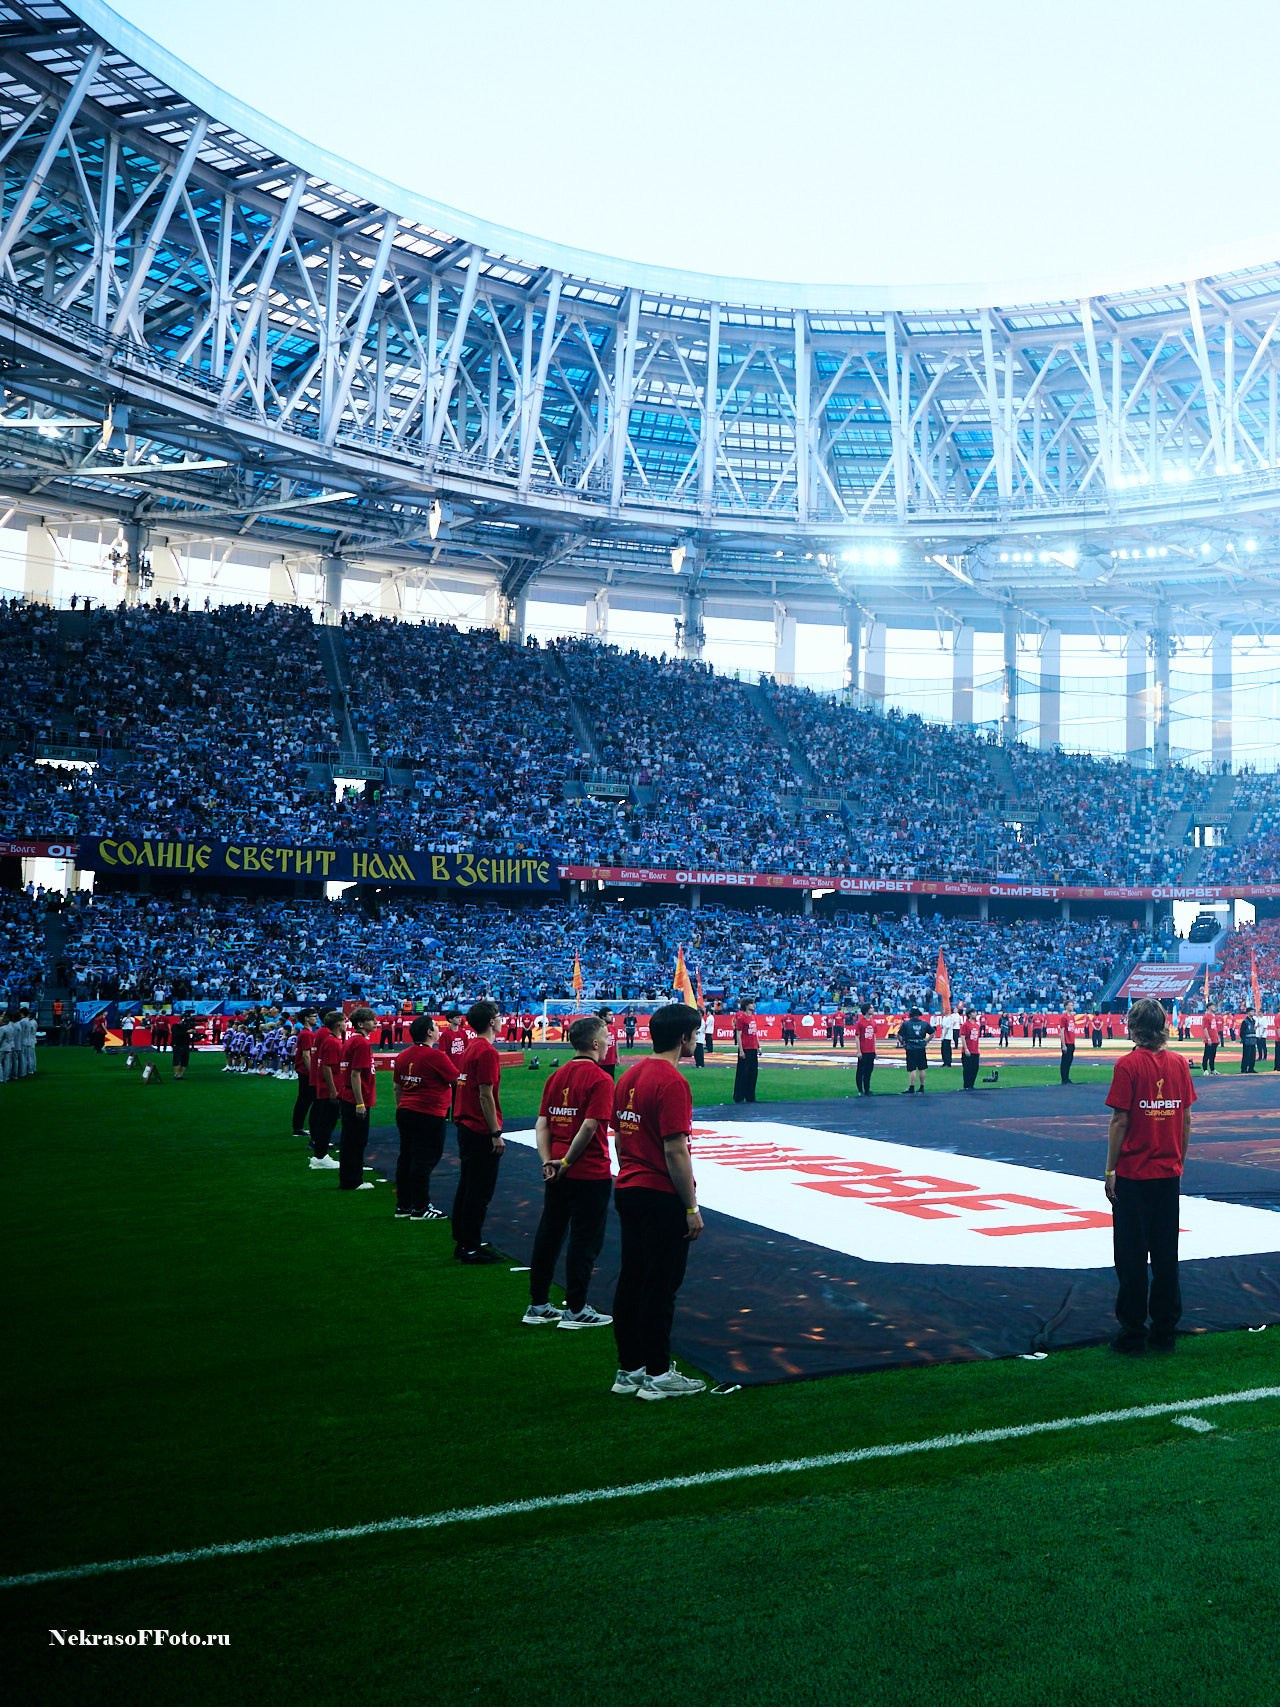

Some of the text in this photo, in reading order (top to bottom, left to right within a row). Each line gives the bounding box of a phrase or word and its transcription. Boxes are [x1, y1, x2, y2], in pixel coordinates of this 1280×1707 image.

[675, 872, 757, 885] OLIMPBET
[839, 879, 914, 891] OLIMPBET
[989, 886, 1060, 897] OLIMPBET
[1151, 888, 1222, 898] OLIMPBET
[1139, 1100, 1181, 1109] OLMPBET
